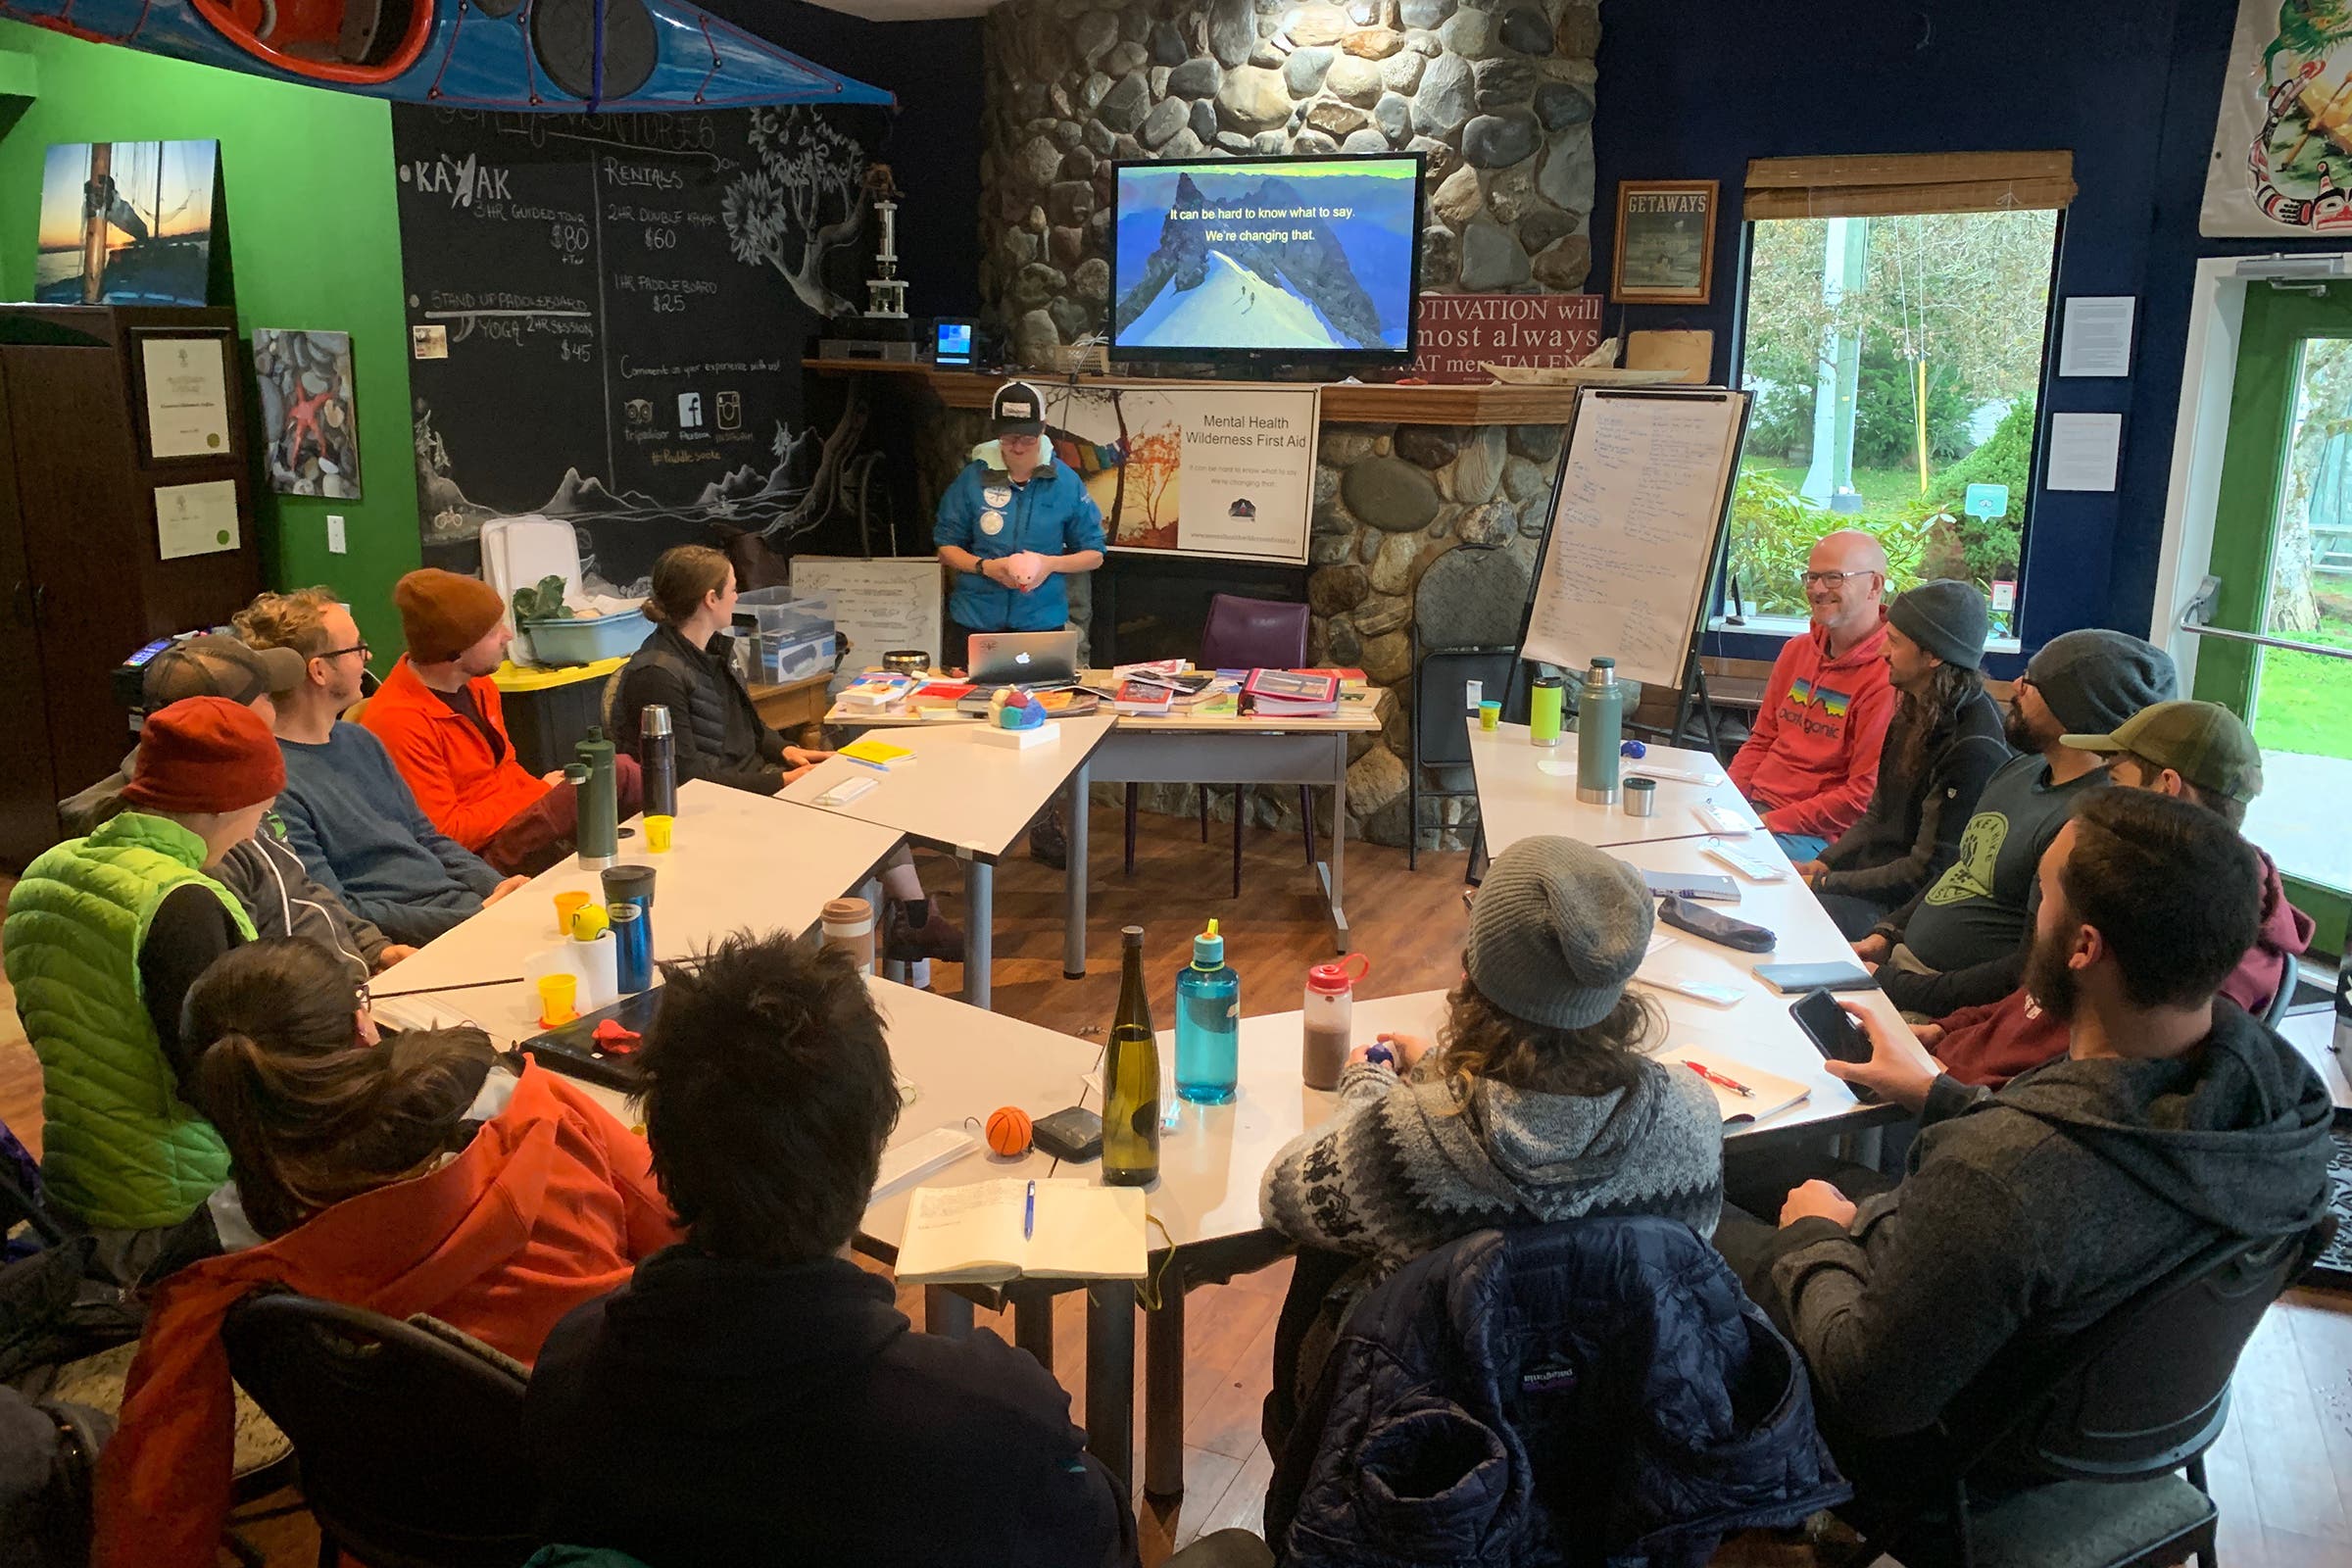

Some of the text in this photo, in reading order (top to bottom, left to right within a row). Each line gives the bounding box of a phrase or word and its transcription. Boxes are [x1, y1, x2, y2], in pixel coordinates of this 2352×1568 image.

[603, 157, 683, 190] RENTALS
[1170, 207, 1355, 220] It can be hard to know what to say.
[1629, 195, 1707, 213] GETAWAYS
[512, 204, 555, 220] GUIDED
[557, 211, 588, 226] TOUR
[639, 207, 682, 224] DOUBLE
[551, 224, 589, 253] $80
[645, 226, 676, 250] $60
[1205, 229, 1315, 243] We're changing that.
[431, 290, 476, 309] STAND
[479, 292, 495, 307] UP
[653, 293, 686, 313] $25
[1417, 299, 1599, 320] TIVATION will
[477, 318, 524, 347] YOGA
[1417, 322, 1598, 353] most always
[560, 338, 593, 363] $45
[1410, 354, 1441, 372] AT
[1501, 354, 1582, 368] TALEN
[1203, 415, 1289, 429] Mental Health
[1186, 431, 1306, 448] Wilderness First Aid
